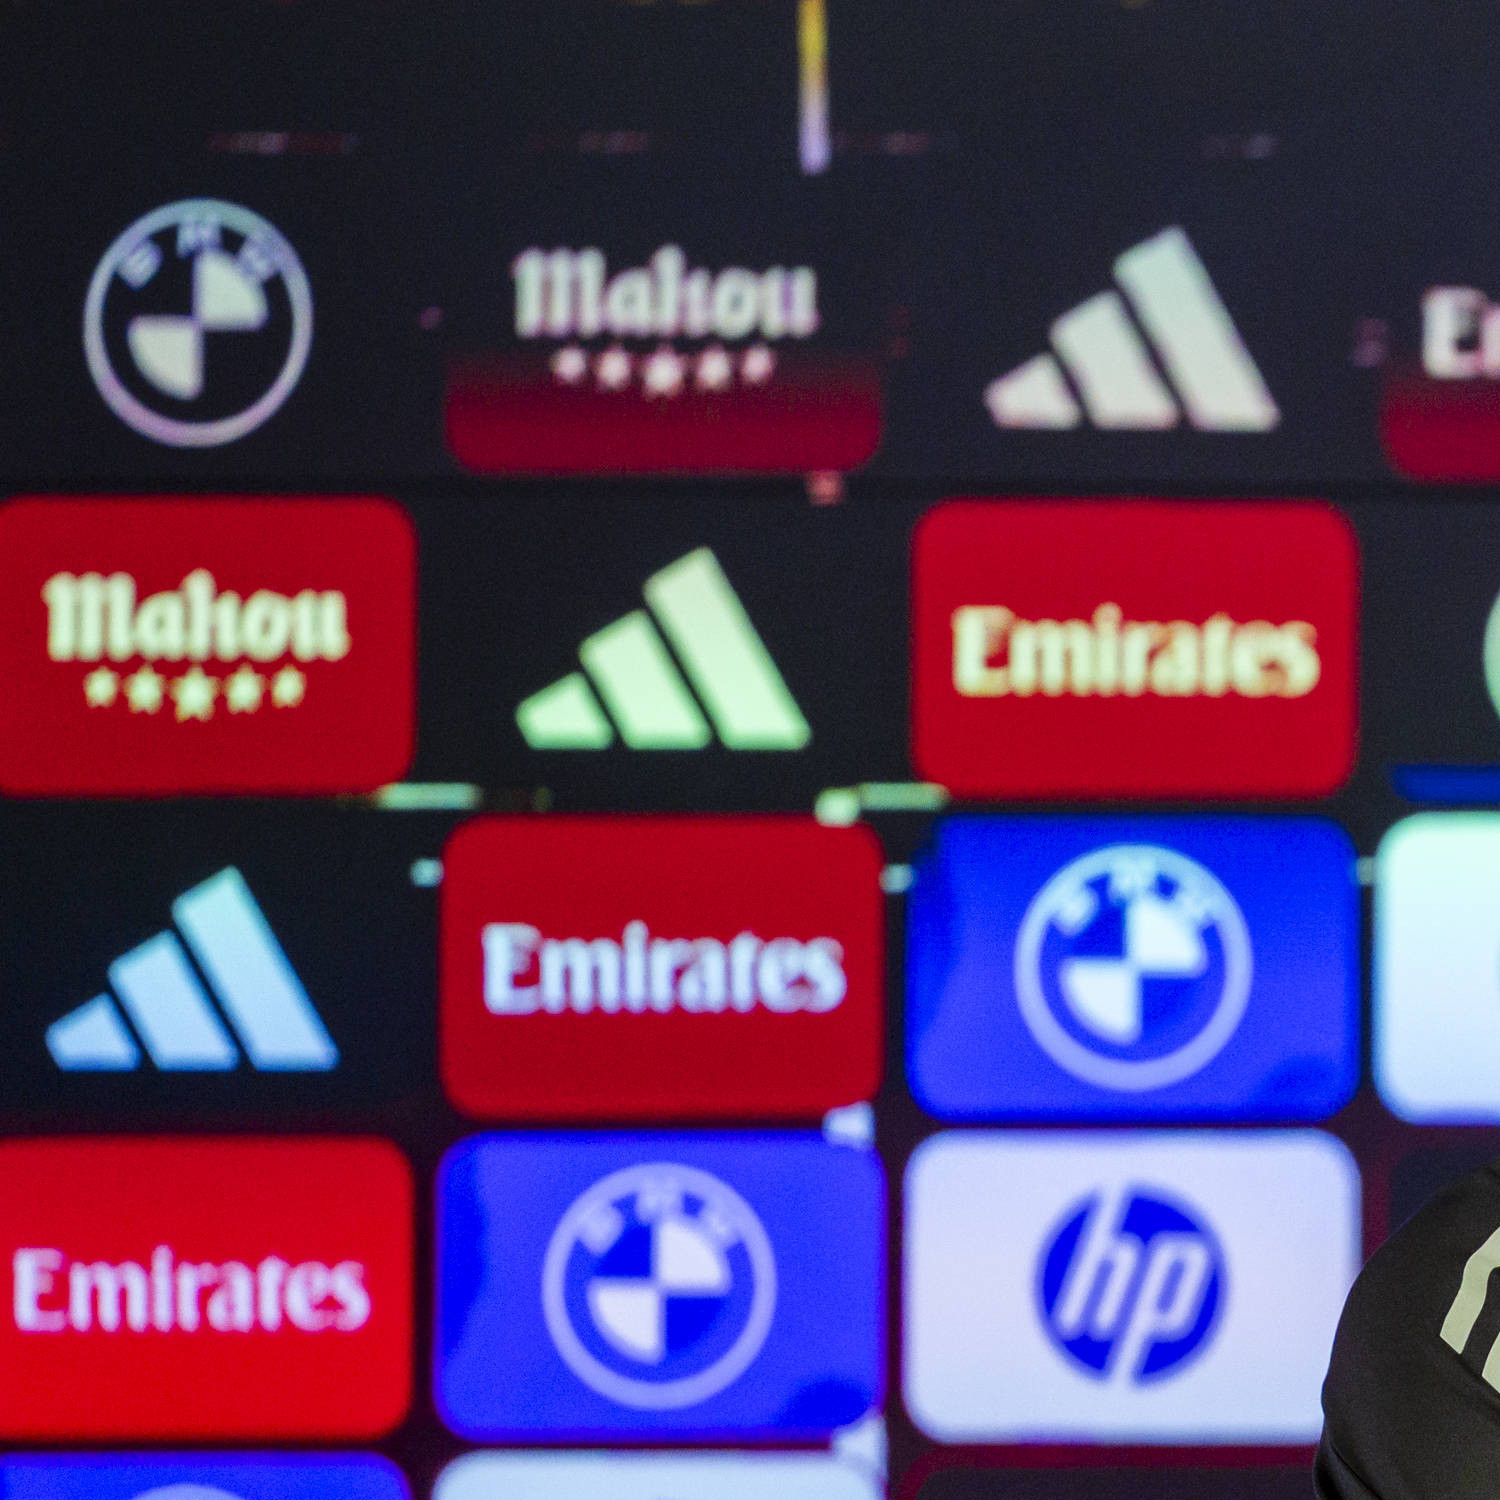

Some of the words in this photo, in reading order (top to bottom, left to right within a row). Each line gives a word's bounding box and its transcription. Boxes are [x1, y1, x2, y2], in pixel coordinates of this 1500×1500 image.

[953, 605, 1319, 696] Emirates
[483, 921, 845, 1012] Emirates
[14, 1247, 369, 1330] Emirates
[1053, 1190, 1213, 1383] hp
